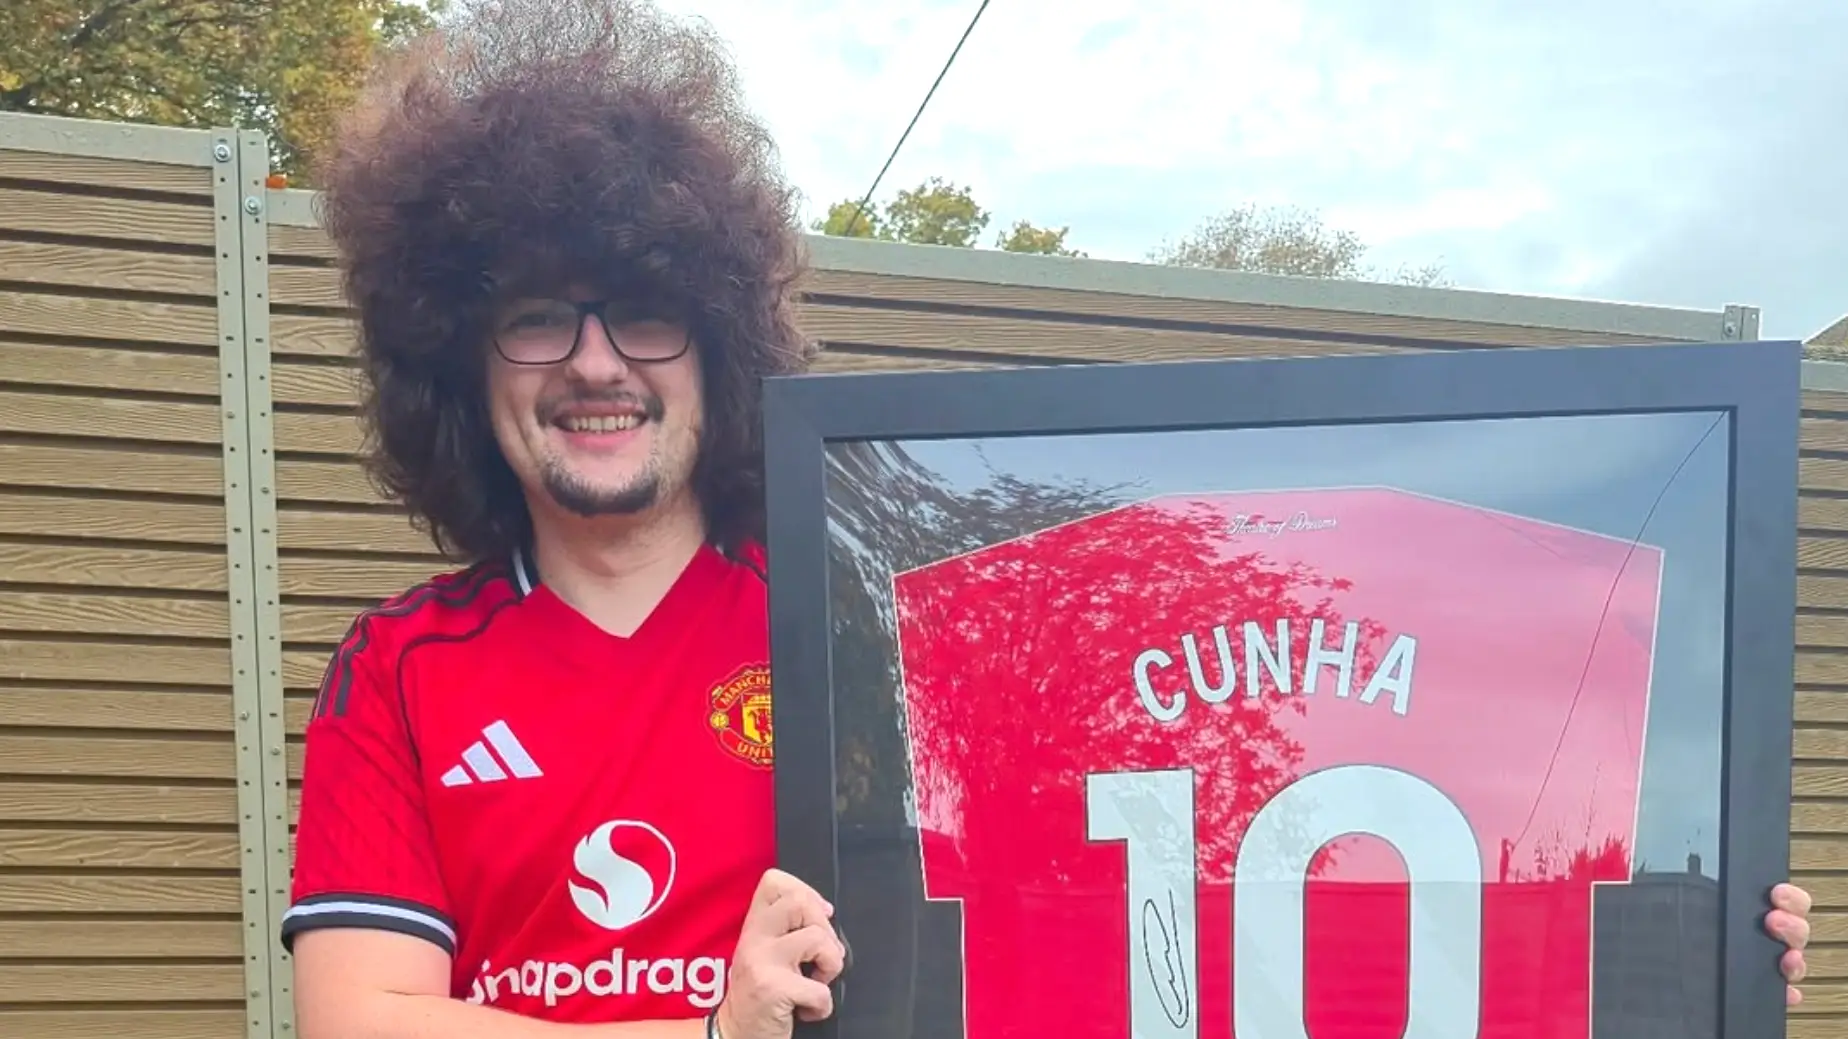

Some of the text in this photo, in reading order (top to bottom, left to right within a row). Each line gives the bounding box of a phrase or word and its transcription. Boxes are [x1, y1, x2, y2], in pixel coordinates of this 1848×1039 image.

[720, 674, 771, 705] MANCH
[1133, 618, 1417, 722] CUNHA
[1086, 765, 1482, 1039] 10
